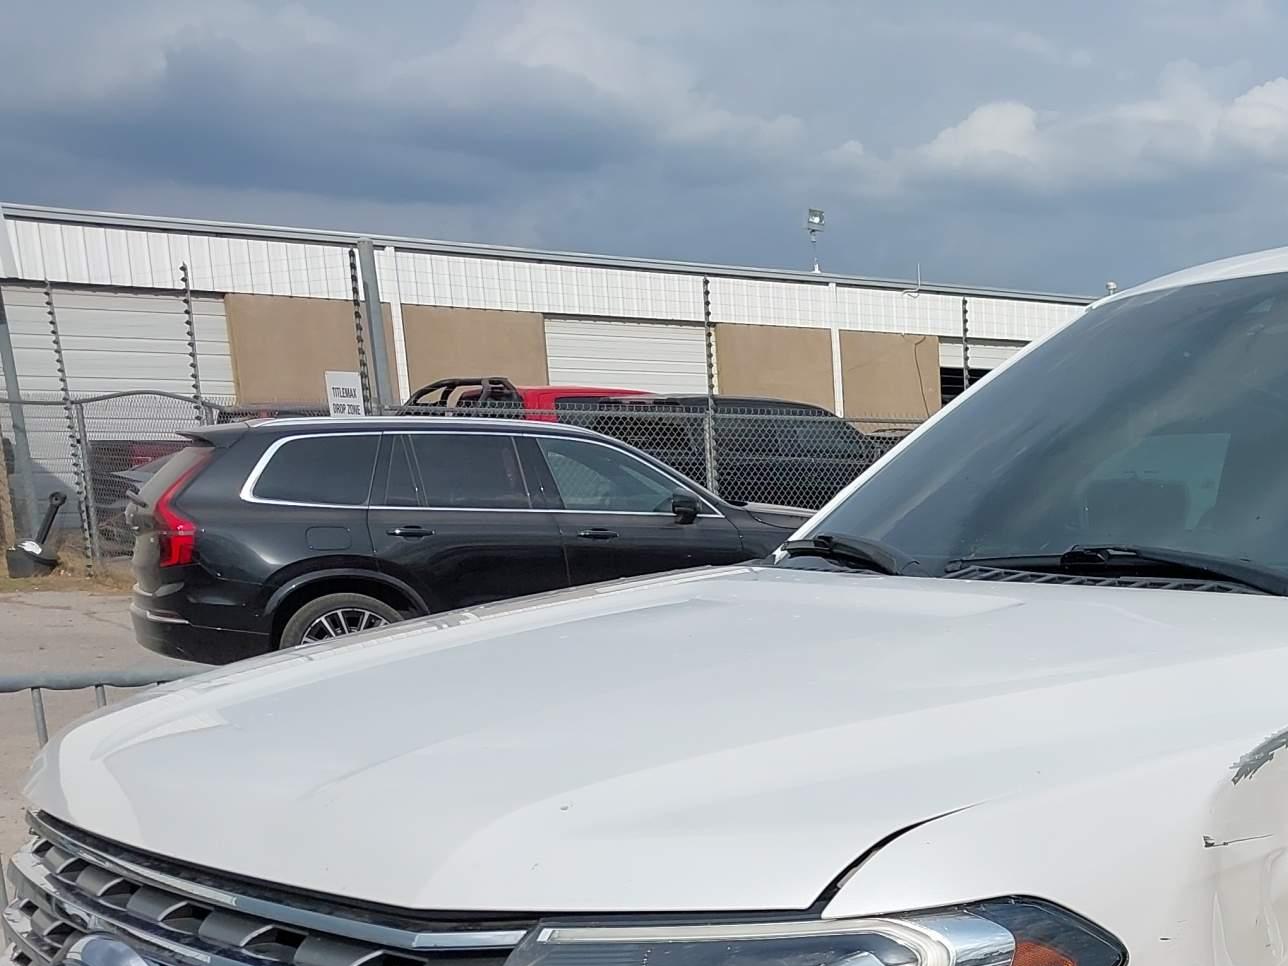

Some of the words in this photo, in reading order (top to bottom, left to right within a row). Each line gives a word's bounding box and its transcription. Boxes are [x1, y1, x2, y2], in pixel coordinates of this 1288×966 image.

[332, 386, 357, 399] TITLEMAX
[332, 403, 346, 414] DROP
[347, 404, 361, 416] ZONE
